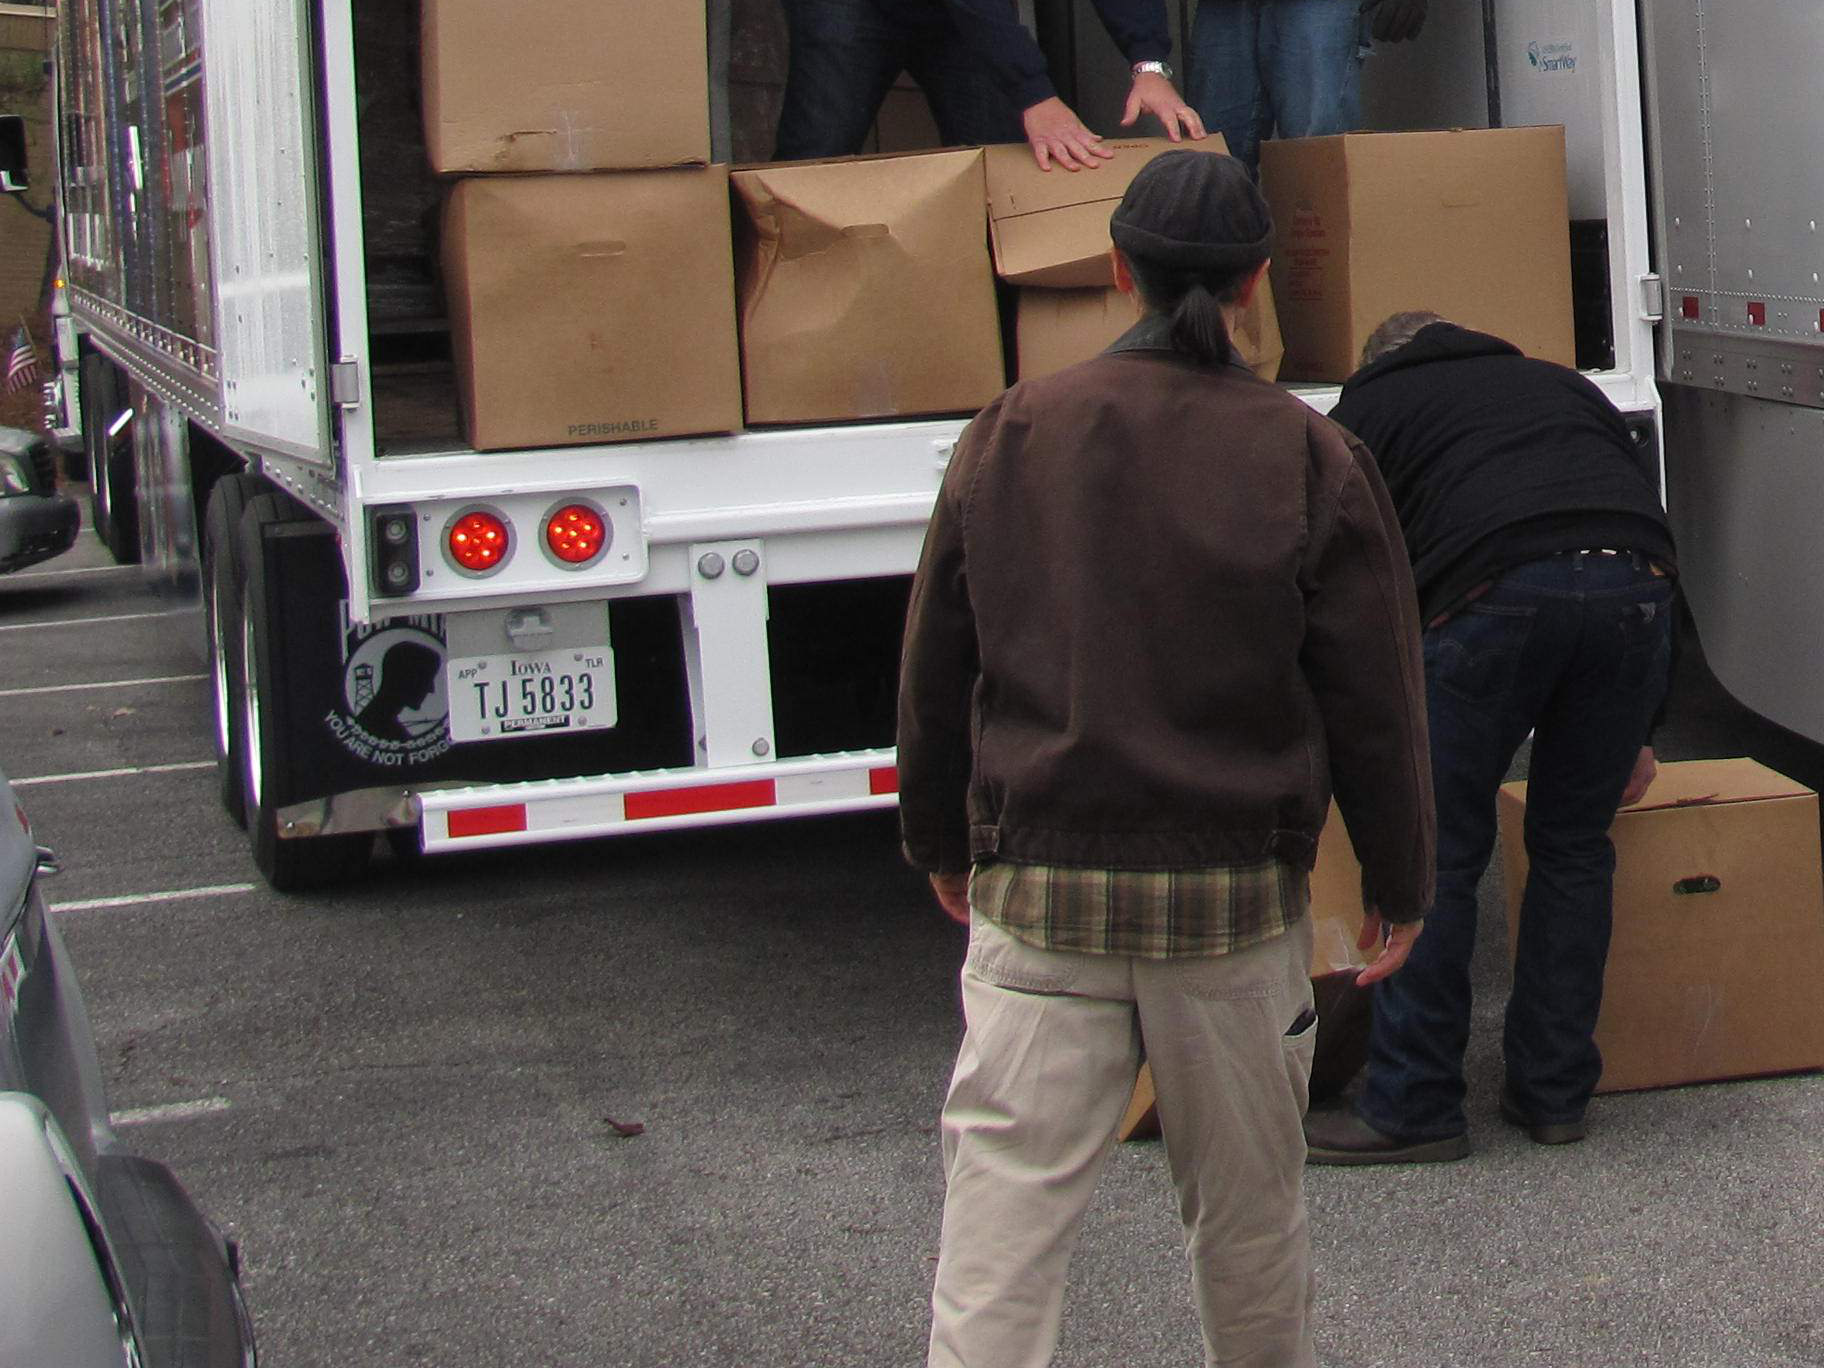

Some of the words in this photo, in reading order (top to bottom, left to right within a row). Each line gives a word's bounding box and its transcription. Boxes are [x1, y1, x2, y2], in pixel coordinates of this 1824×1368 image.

[567, 419, 659, 437] PERISHABLE
[458, 668, 478, 681] APP
[585, 656, 604, 670] TLR
[473, 679, 509, 720] TJ
[521, 672, 595, 715] 5833
[324, 709, 348, 738] YOU
[343, 736, 373, 759] ARE
[372, 750, 405, 766] NOT
